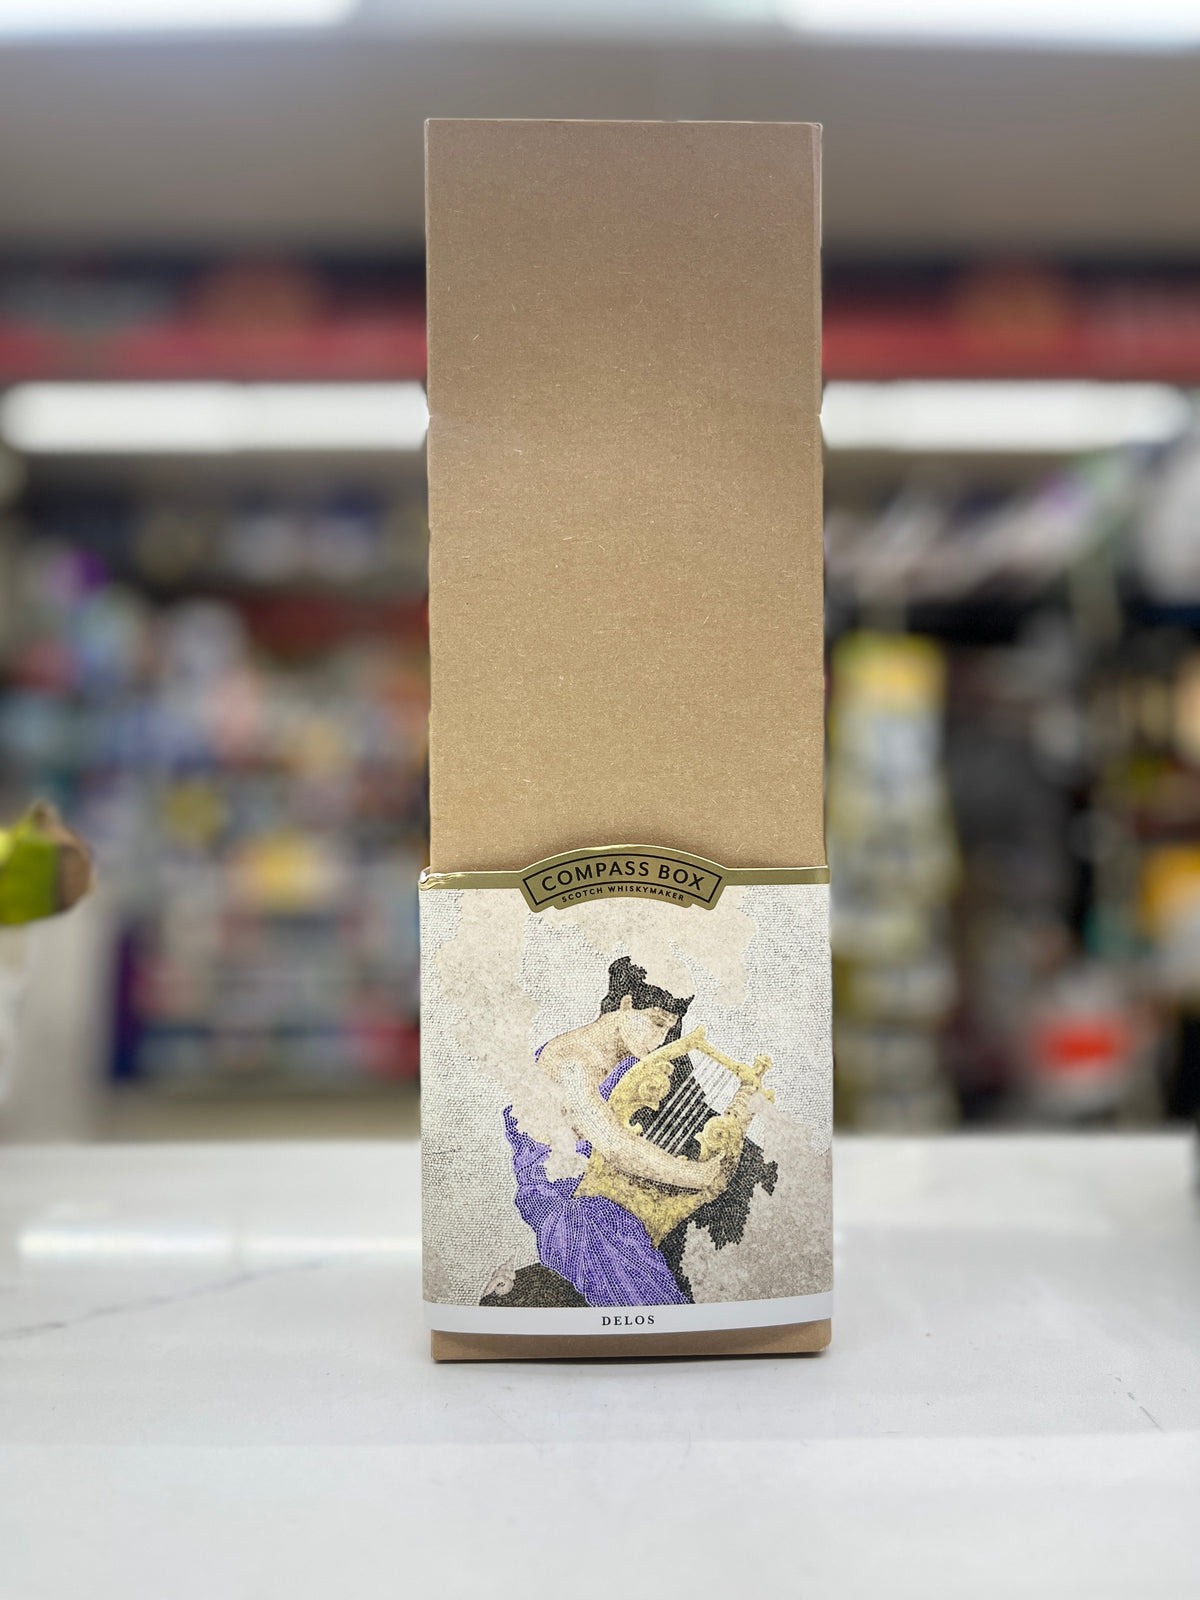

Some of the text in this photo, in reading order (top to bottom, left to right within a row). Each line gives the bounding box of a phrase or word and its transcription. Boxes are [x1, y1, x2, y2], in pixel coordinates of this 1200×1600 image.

[541, 860, 705, 892] COMPASS BOX
[561, 885, 685, 903] SCOTCH WHISKYMAKER
[601, 1314, 655, 1326] DELOS
